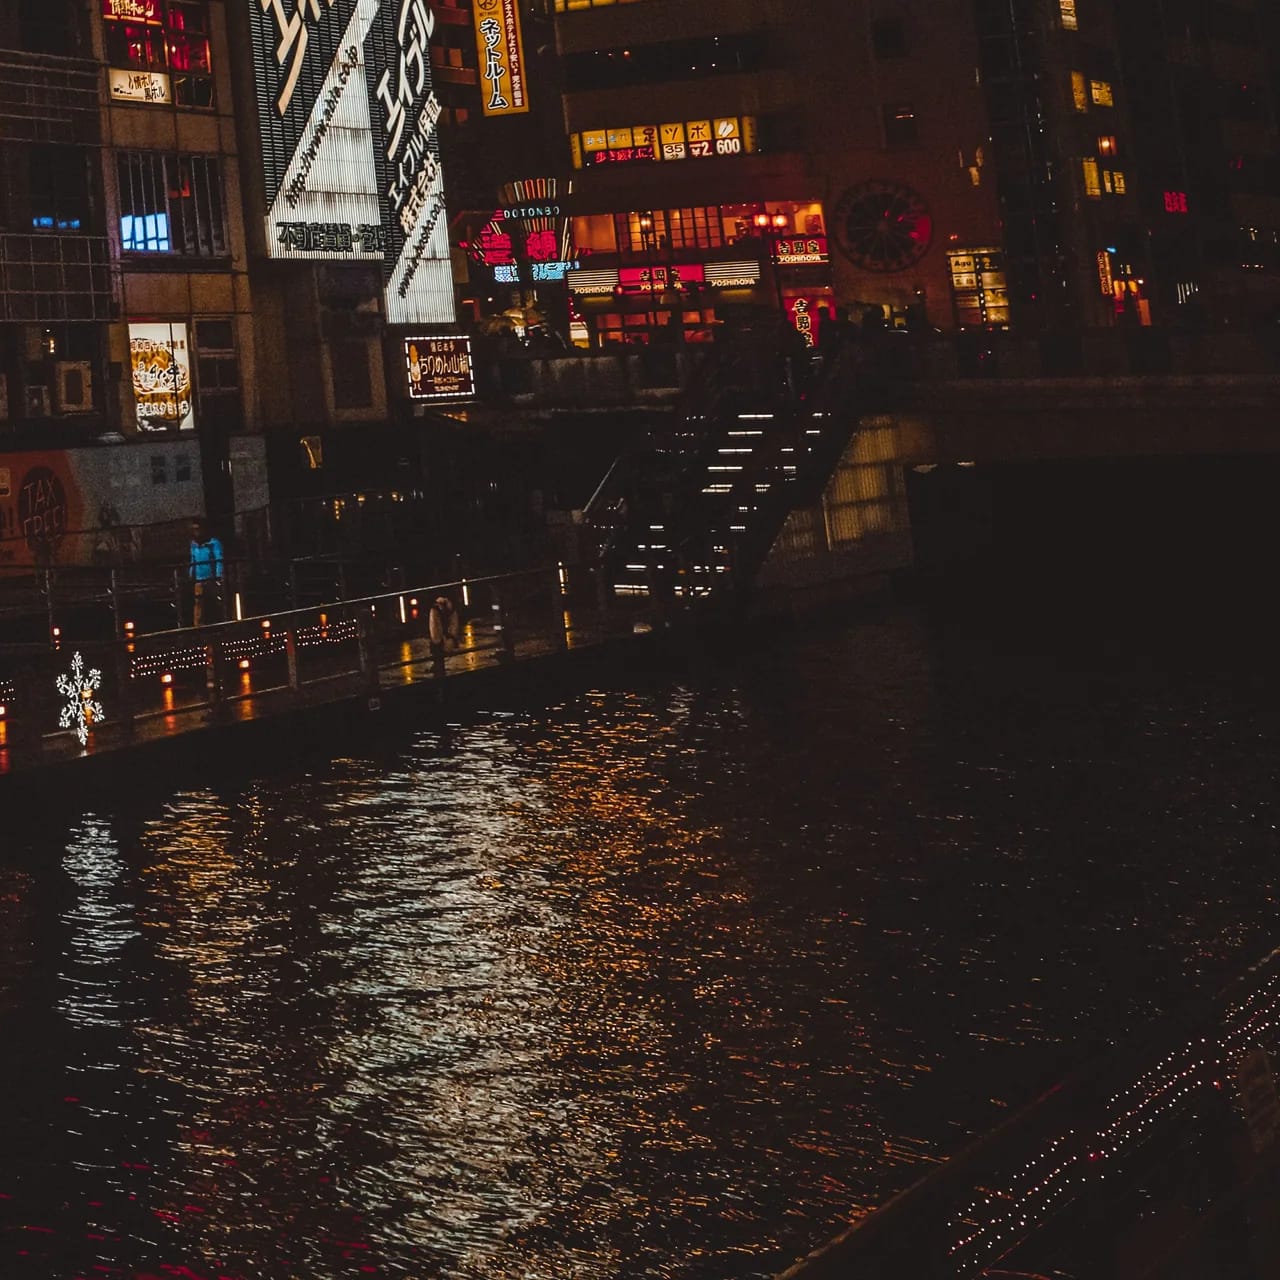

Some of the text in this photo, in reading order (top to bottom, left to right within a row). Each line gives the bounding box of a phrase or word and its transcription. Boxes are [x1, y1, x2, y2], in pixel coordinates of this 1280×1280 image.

[480, 18, 509, 111] ネットルーム
